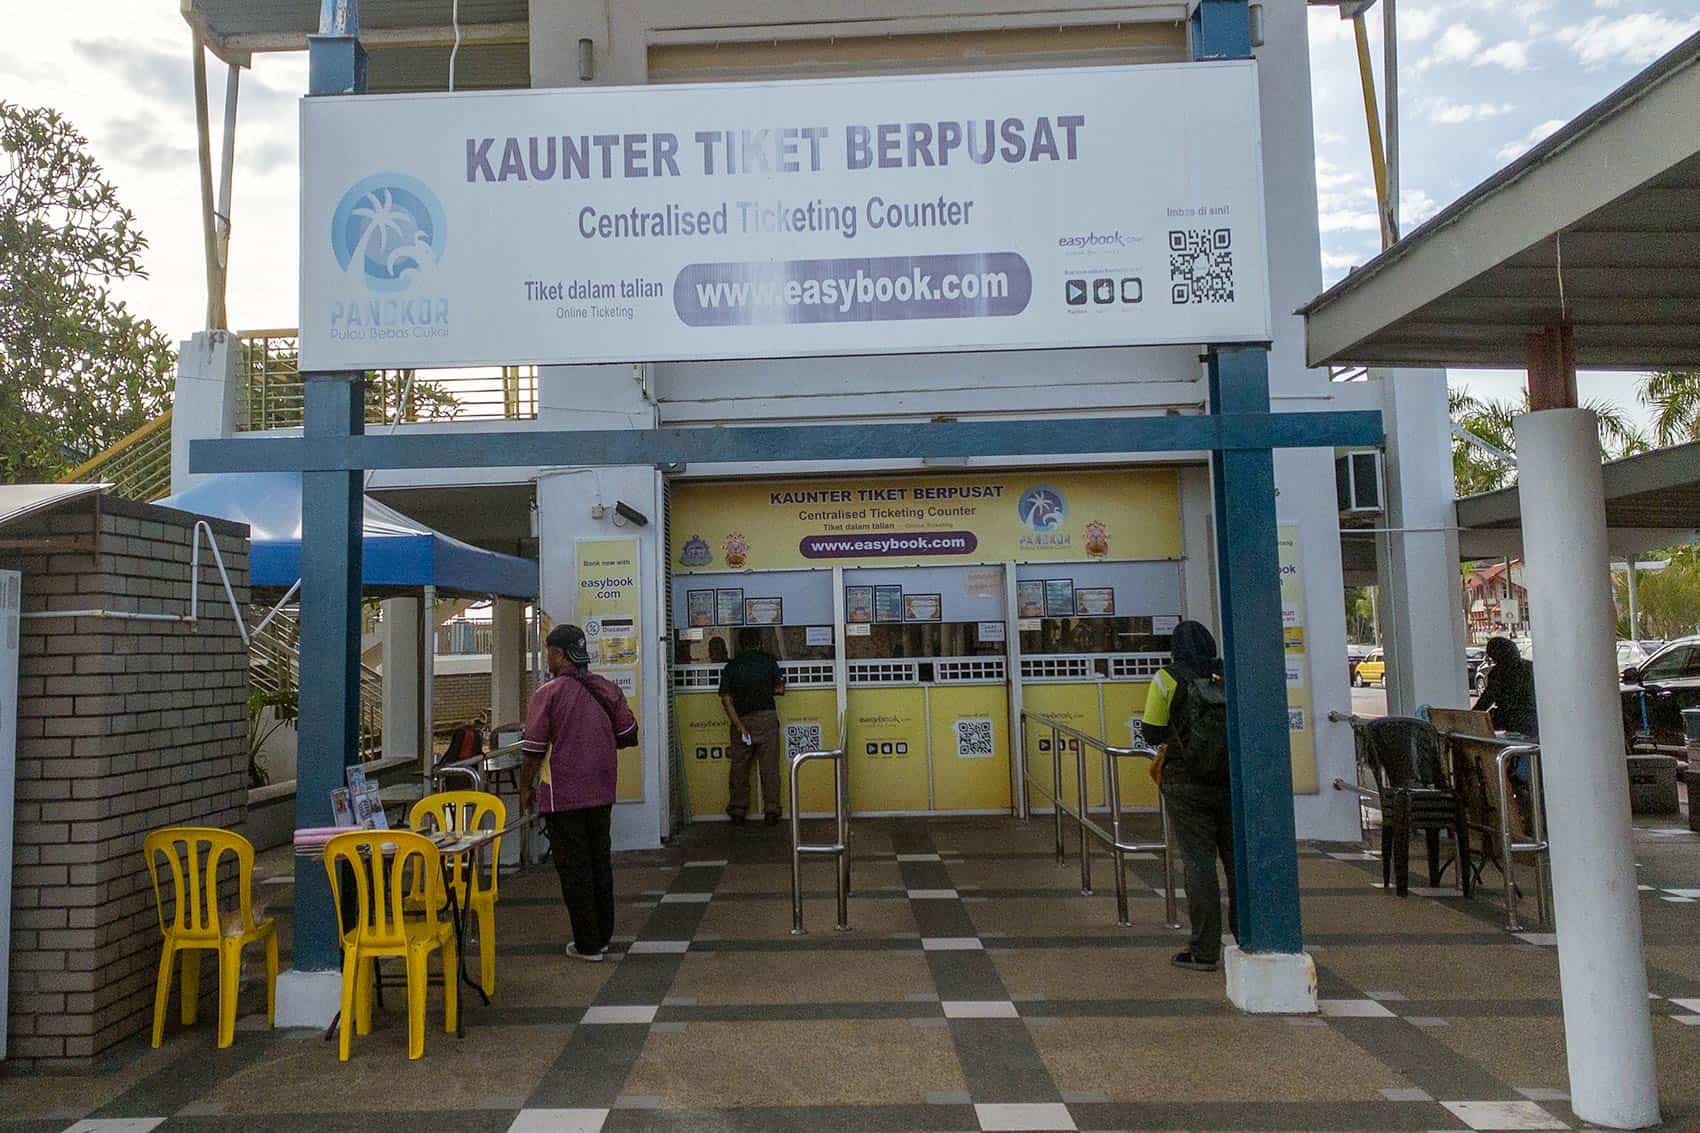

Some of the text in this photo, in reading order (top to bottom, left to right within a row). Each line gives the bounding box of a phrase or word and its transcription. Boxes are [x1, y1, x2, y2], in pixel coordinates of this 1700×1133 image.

[465, 115, 1086, 183] KAUNTER TIKET BERPUSAT
[577, 194, 974, 239] Centralised Ticketing Counter
[524, 278, 665, 302] Tiket dalam talian
[695, 267, 1010, 312] www.easybook.com
[556, 305, 634, 320] Online Ticketing
[770, 485, 1005, 505] KAUNTER TIKET BERPUSAT
[798, 506, 977, 521] Centralised Ticketing Counter
[823, 522, 895, 532] Tiket dalam talian
[811, 537, 966, 553] www.easybook.com
[616, 558, 631, 566] with
[580, 577, 634, 591] easybook
[594, 589, 621, 600] .com
